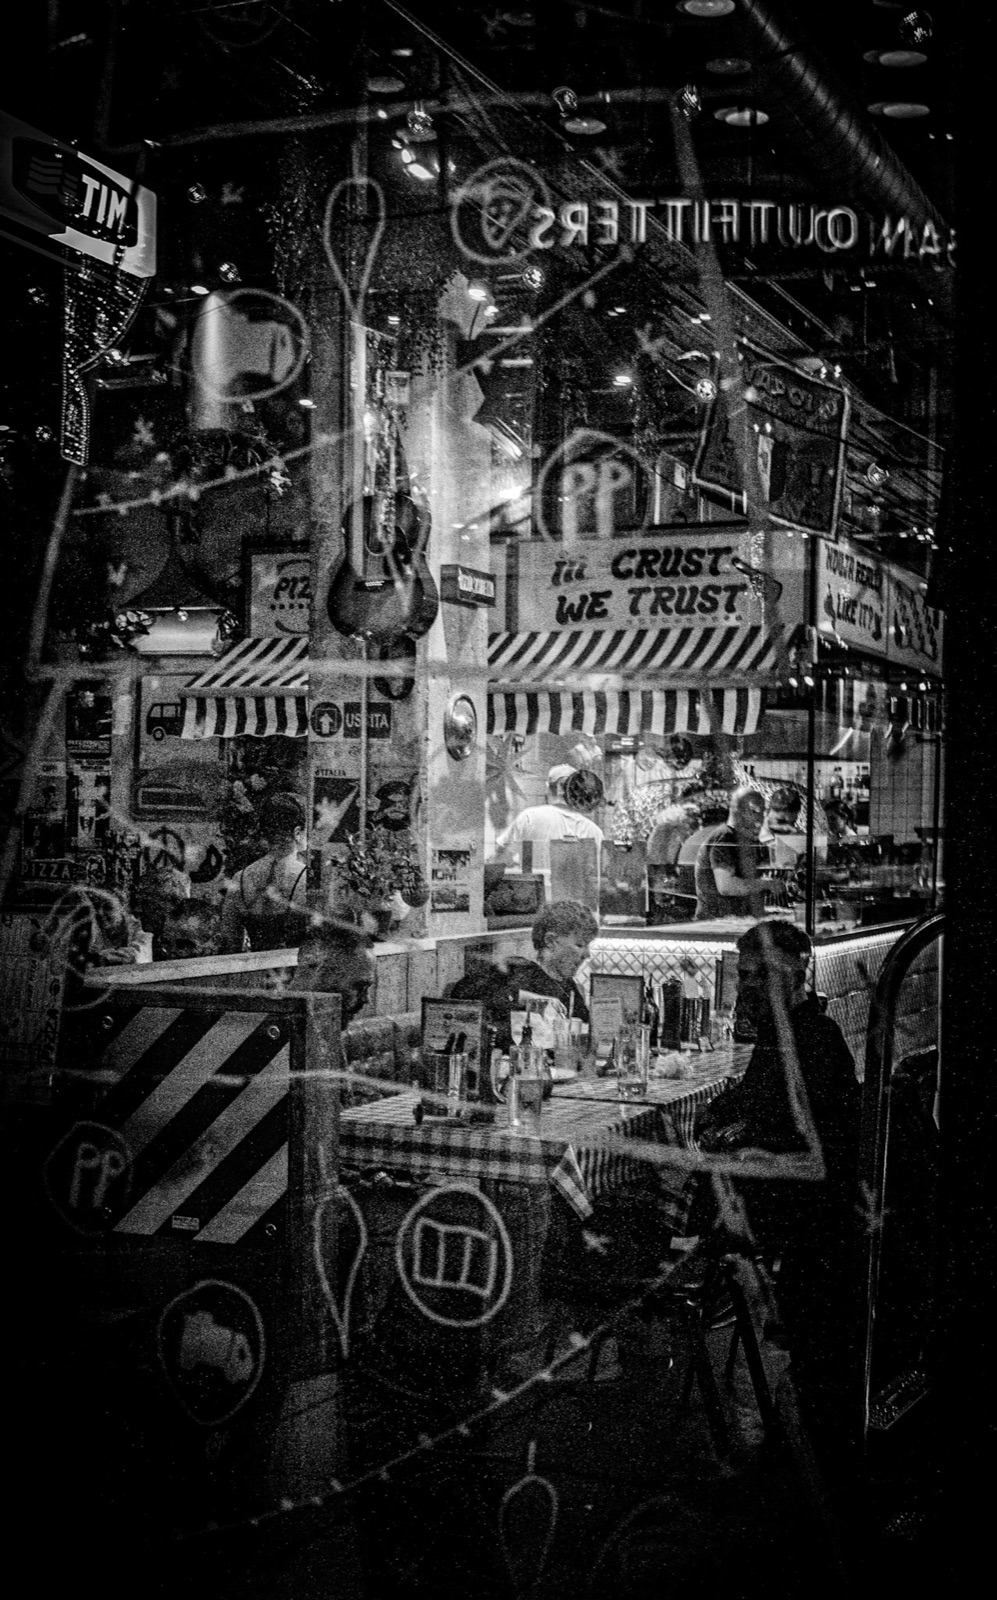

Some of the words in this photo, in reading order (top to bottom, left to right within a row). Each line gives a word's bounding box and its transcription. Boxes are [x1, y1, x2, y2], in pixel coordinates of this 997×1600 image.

[82, 173, 128, 234] TIM
[611, 547, 733, 580] CRUST
[555, 590, 613, 625] WE
[627, 584, 748, 616] TRUST
[345, 713, 389, 728] USITA
[21, 862, 71, 879] PIZZA
